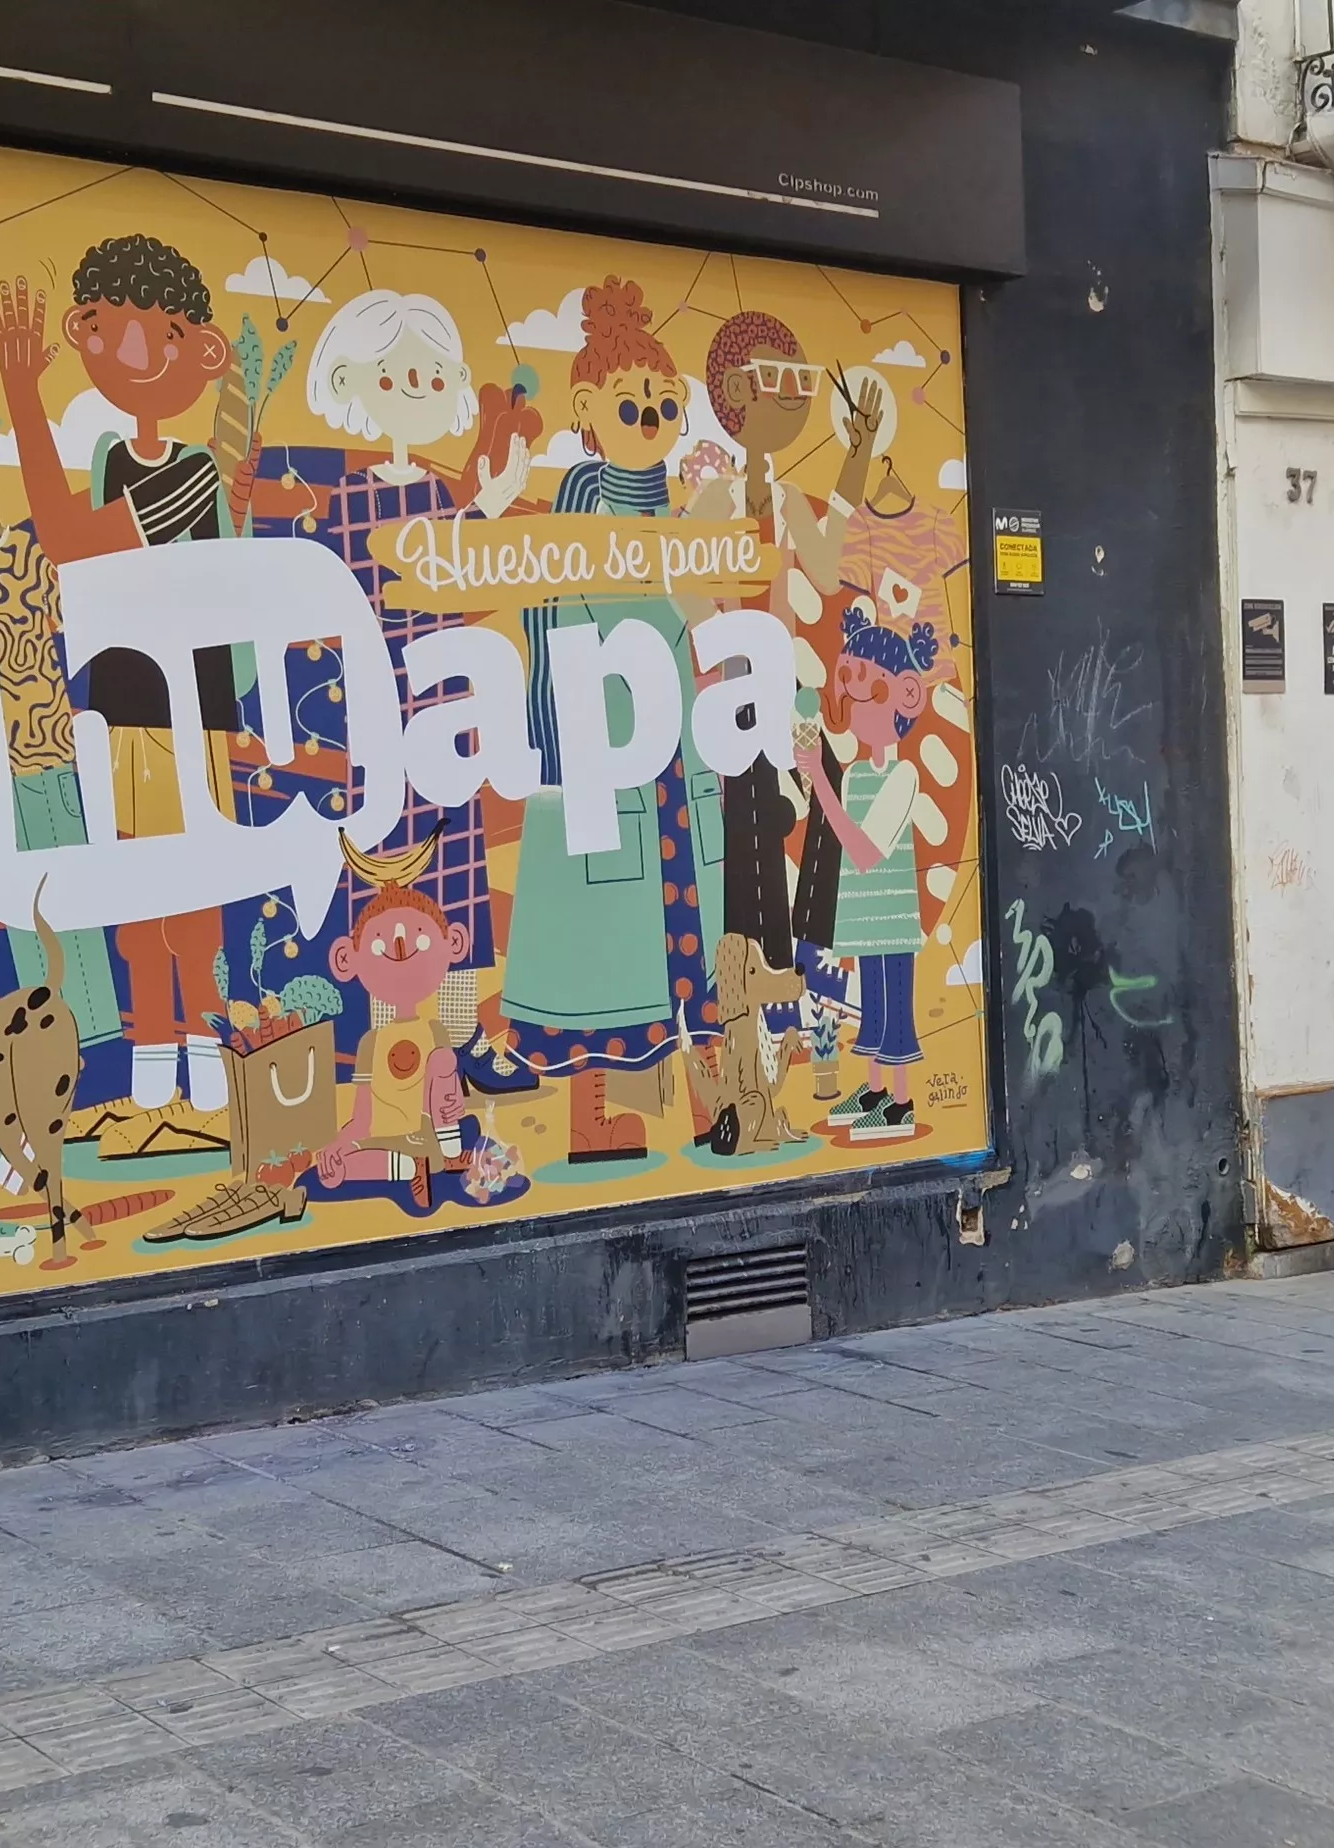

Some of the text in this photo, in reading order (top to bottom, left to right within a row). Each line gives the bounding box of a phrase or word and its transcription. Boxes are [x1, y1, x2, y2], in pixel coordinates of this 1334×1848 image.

[1285, 467, 1317, 504] 37
[395, 508, 761, 594] Huesca se pone
